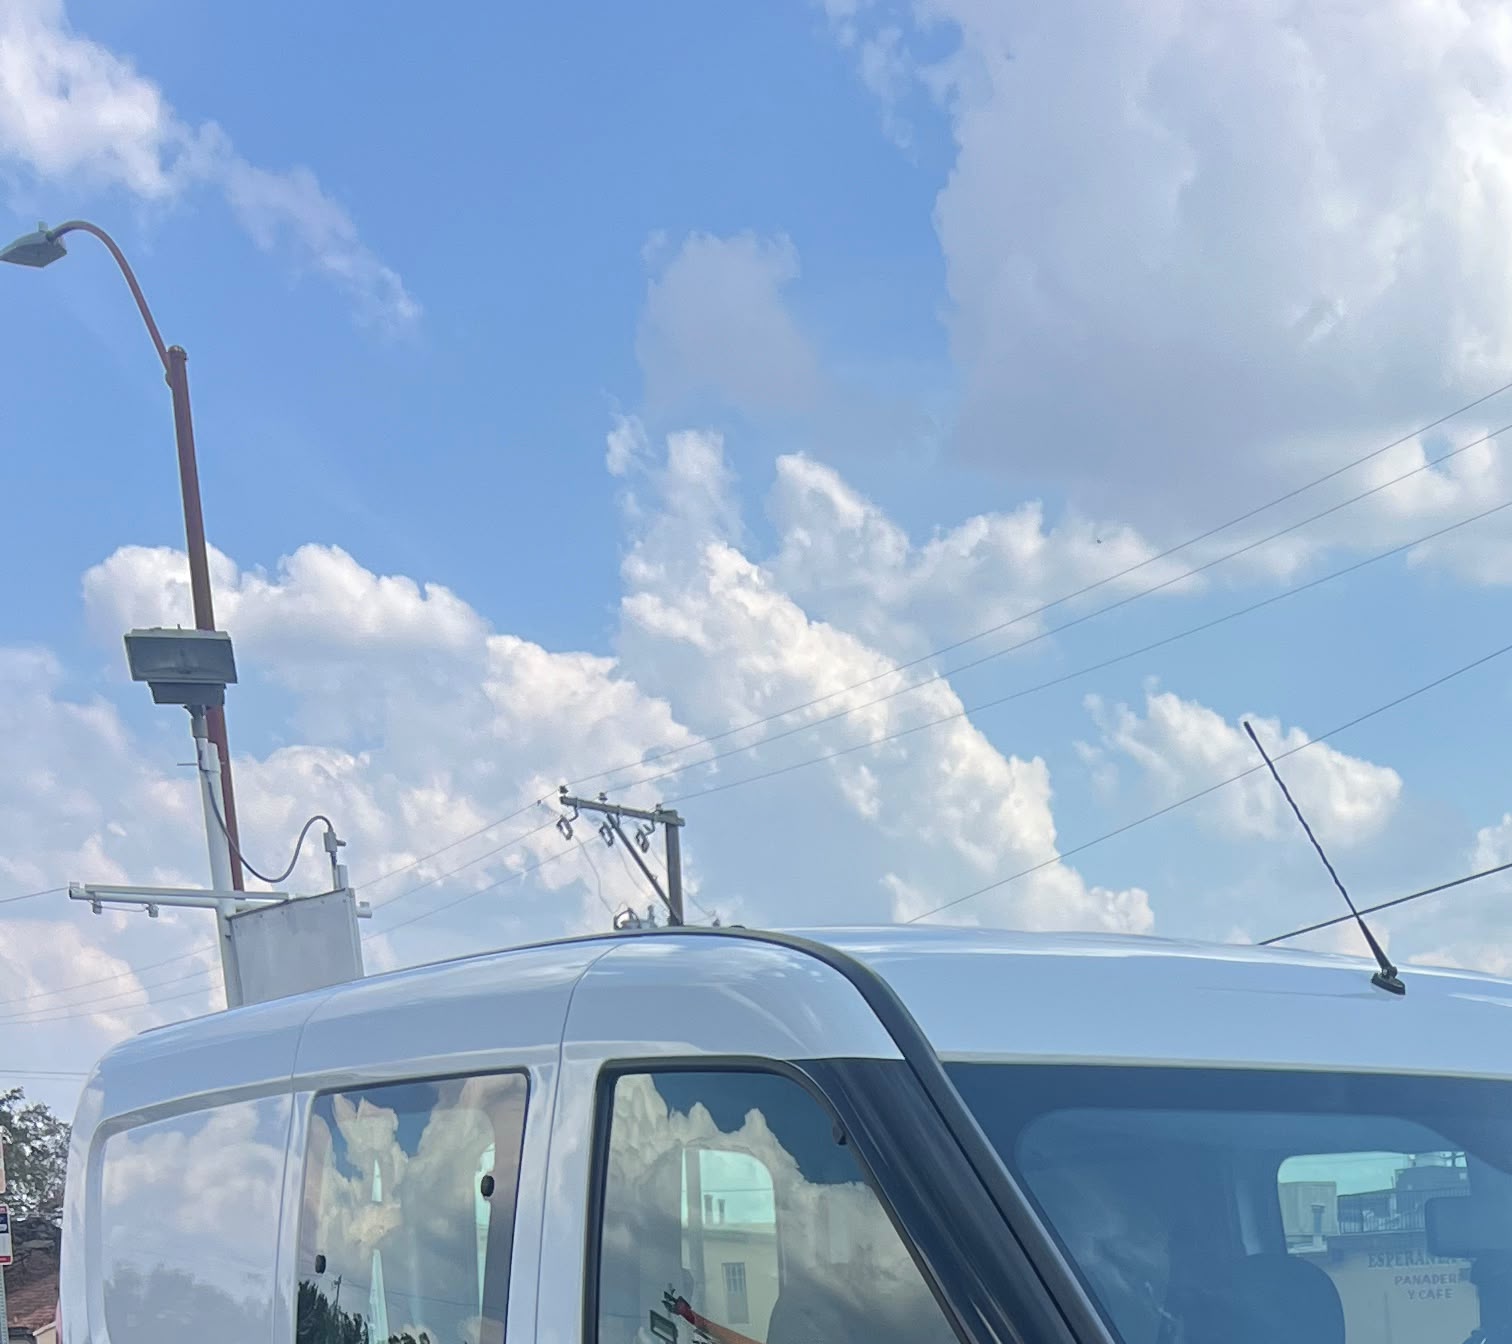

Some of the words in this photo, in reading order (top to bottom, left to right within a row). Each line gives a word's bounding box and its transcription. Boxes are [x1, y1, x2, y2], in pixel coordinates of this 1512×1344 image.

[1394, 1273, 1457, 1286] PANADER
[1407, 1289, 1416, 1300] Y
[1418, 1288, 1454, 1301] CAFE
